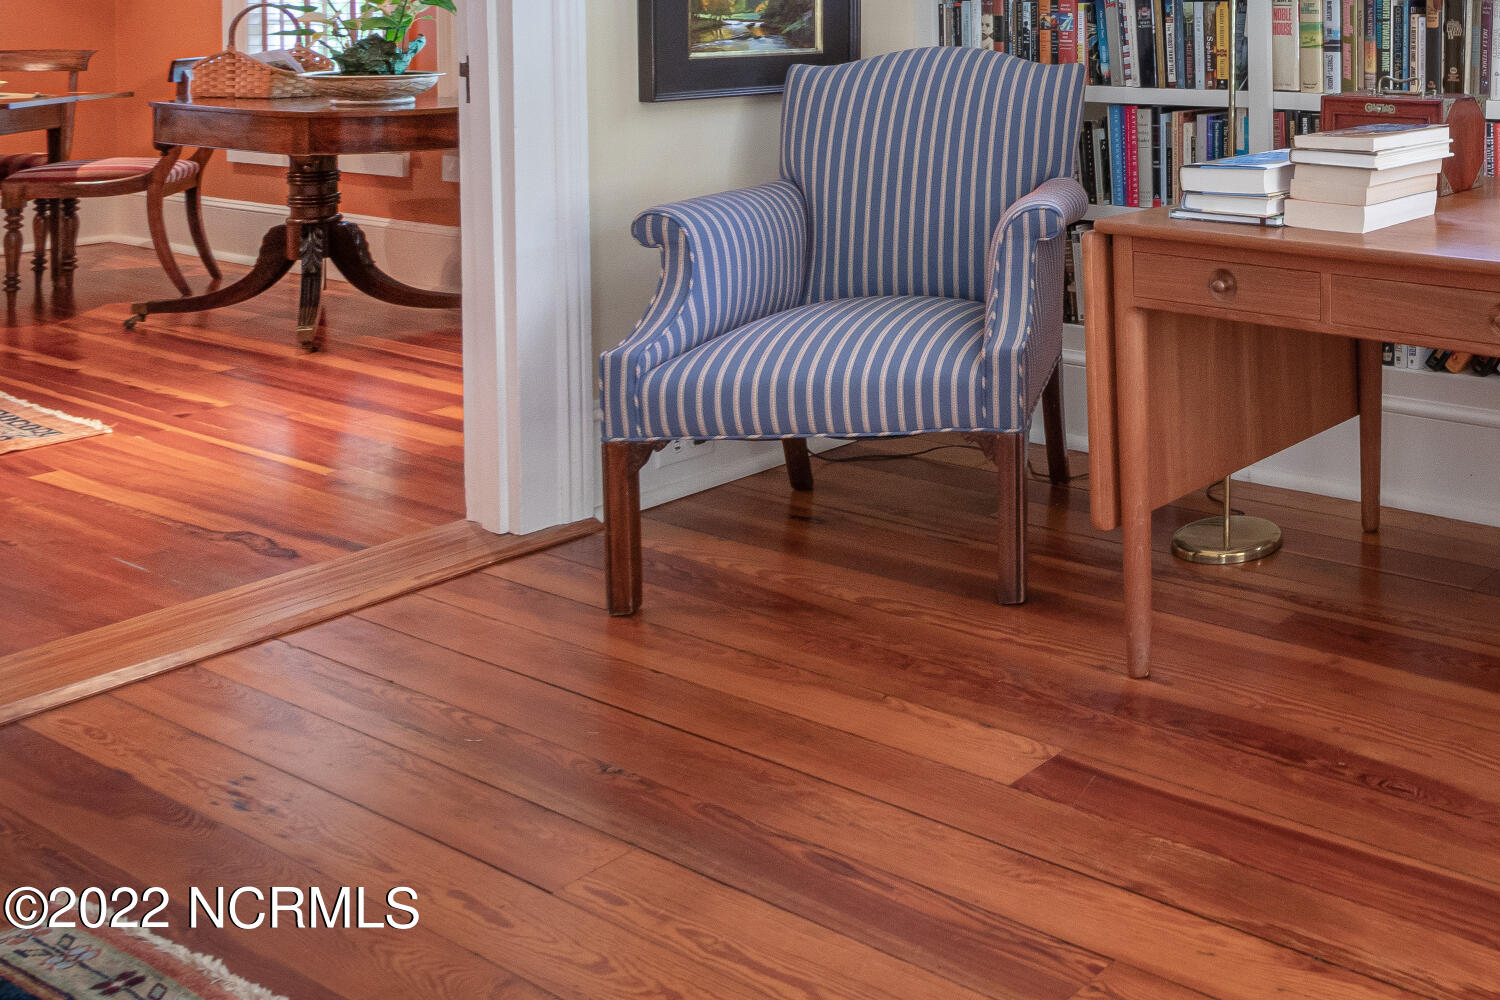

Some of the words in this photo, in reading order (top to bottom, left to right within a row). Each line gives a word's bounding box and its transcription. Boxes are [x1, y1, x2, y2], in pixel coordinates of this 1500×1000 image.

[1274, 8, 1291, 21] NOBLE
[1273, 22, 1292, 36] HOUSE
[1382, 21, 1390, 49] TOWARD
[1382, 52, 1390, 72] HOME
